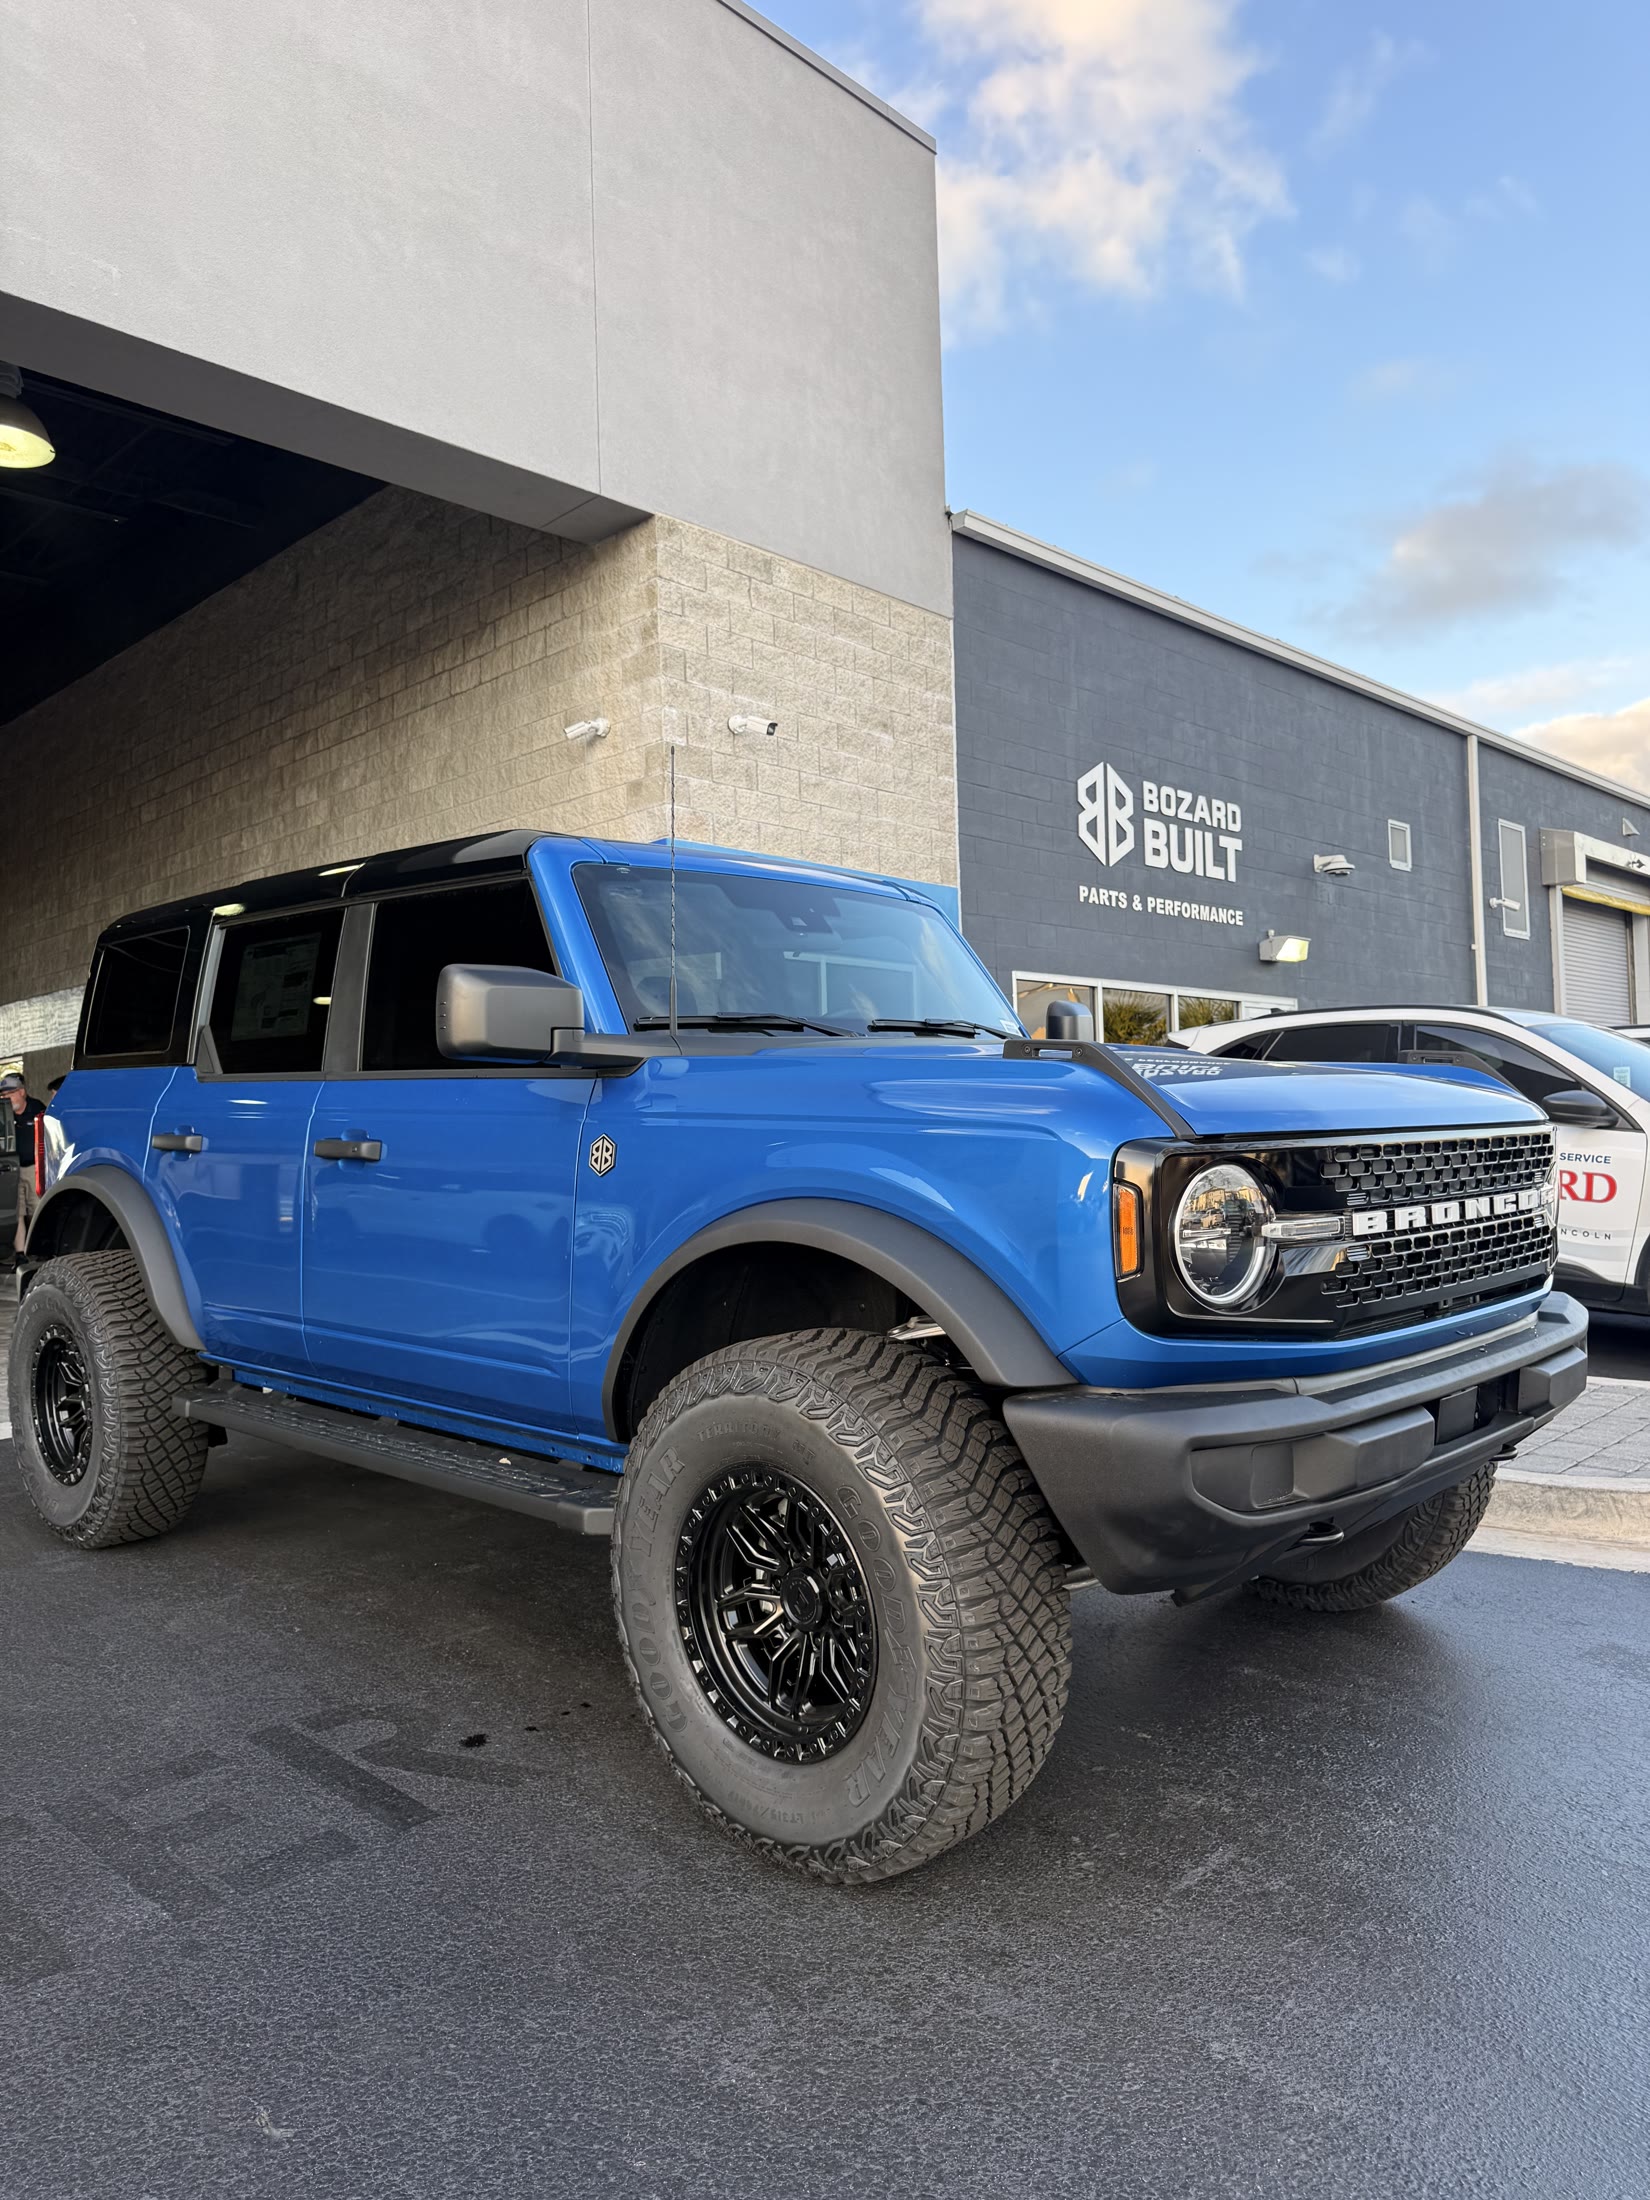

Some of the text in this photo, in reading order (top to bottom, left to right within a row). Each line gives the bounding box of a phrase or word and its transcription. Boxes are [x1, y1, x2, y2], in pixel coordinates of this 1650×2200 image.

[1142, 780, 1242, 832] BOZARD
[1143, 817, 1243, 883] BUILT
[1079, 885, 1244, 926] PARTS & PERFORMANCE
[1559, 1152, 1612, 1165] SERVICE
[1353, 1189, 1539, 1237] BRONCO
